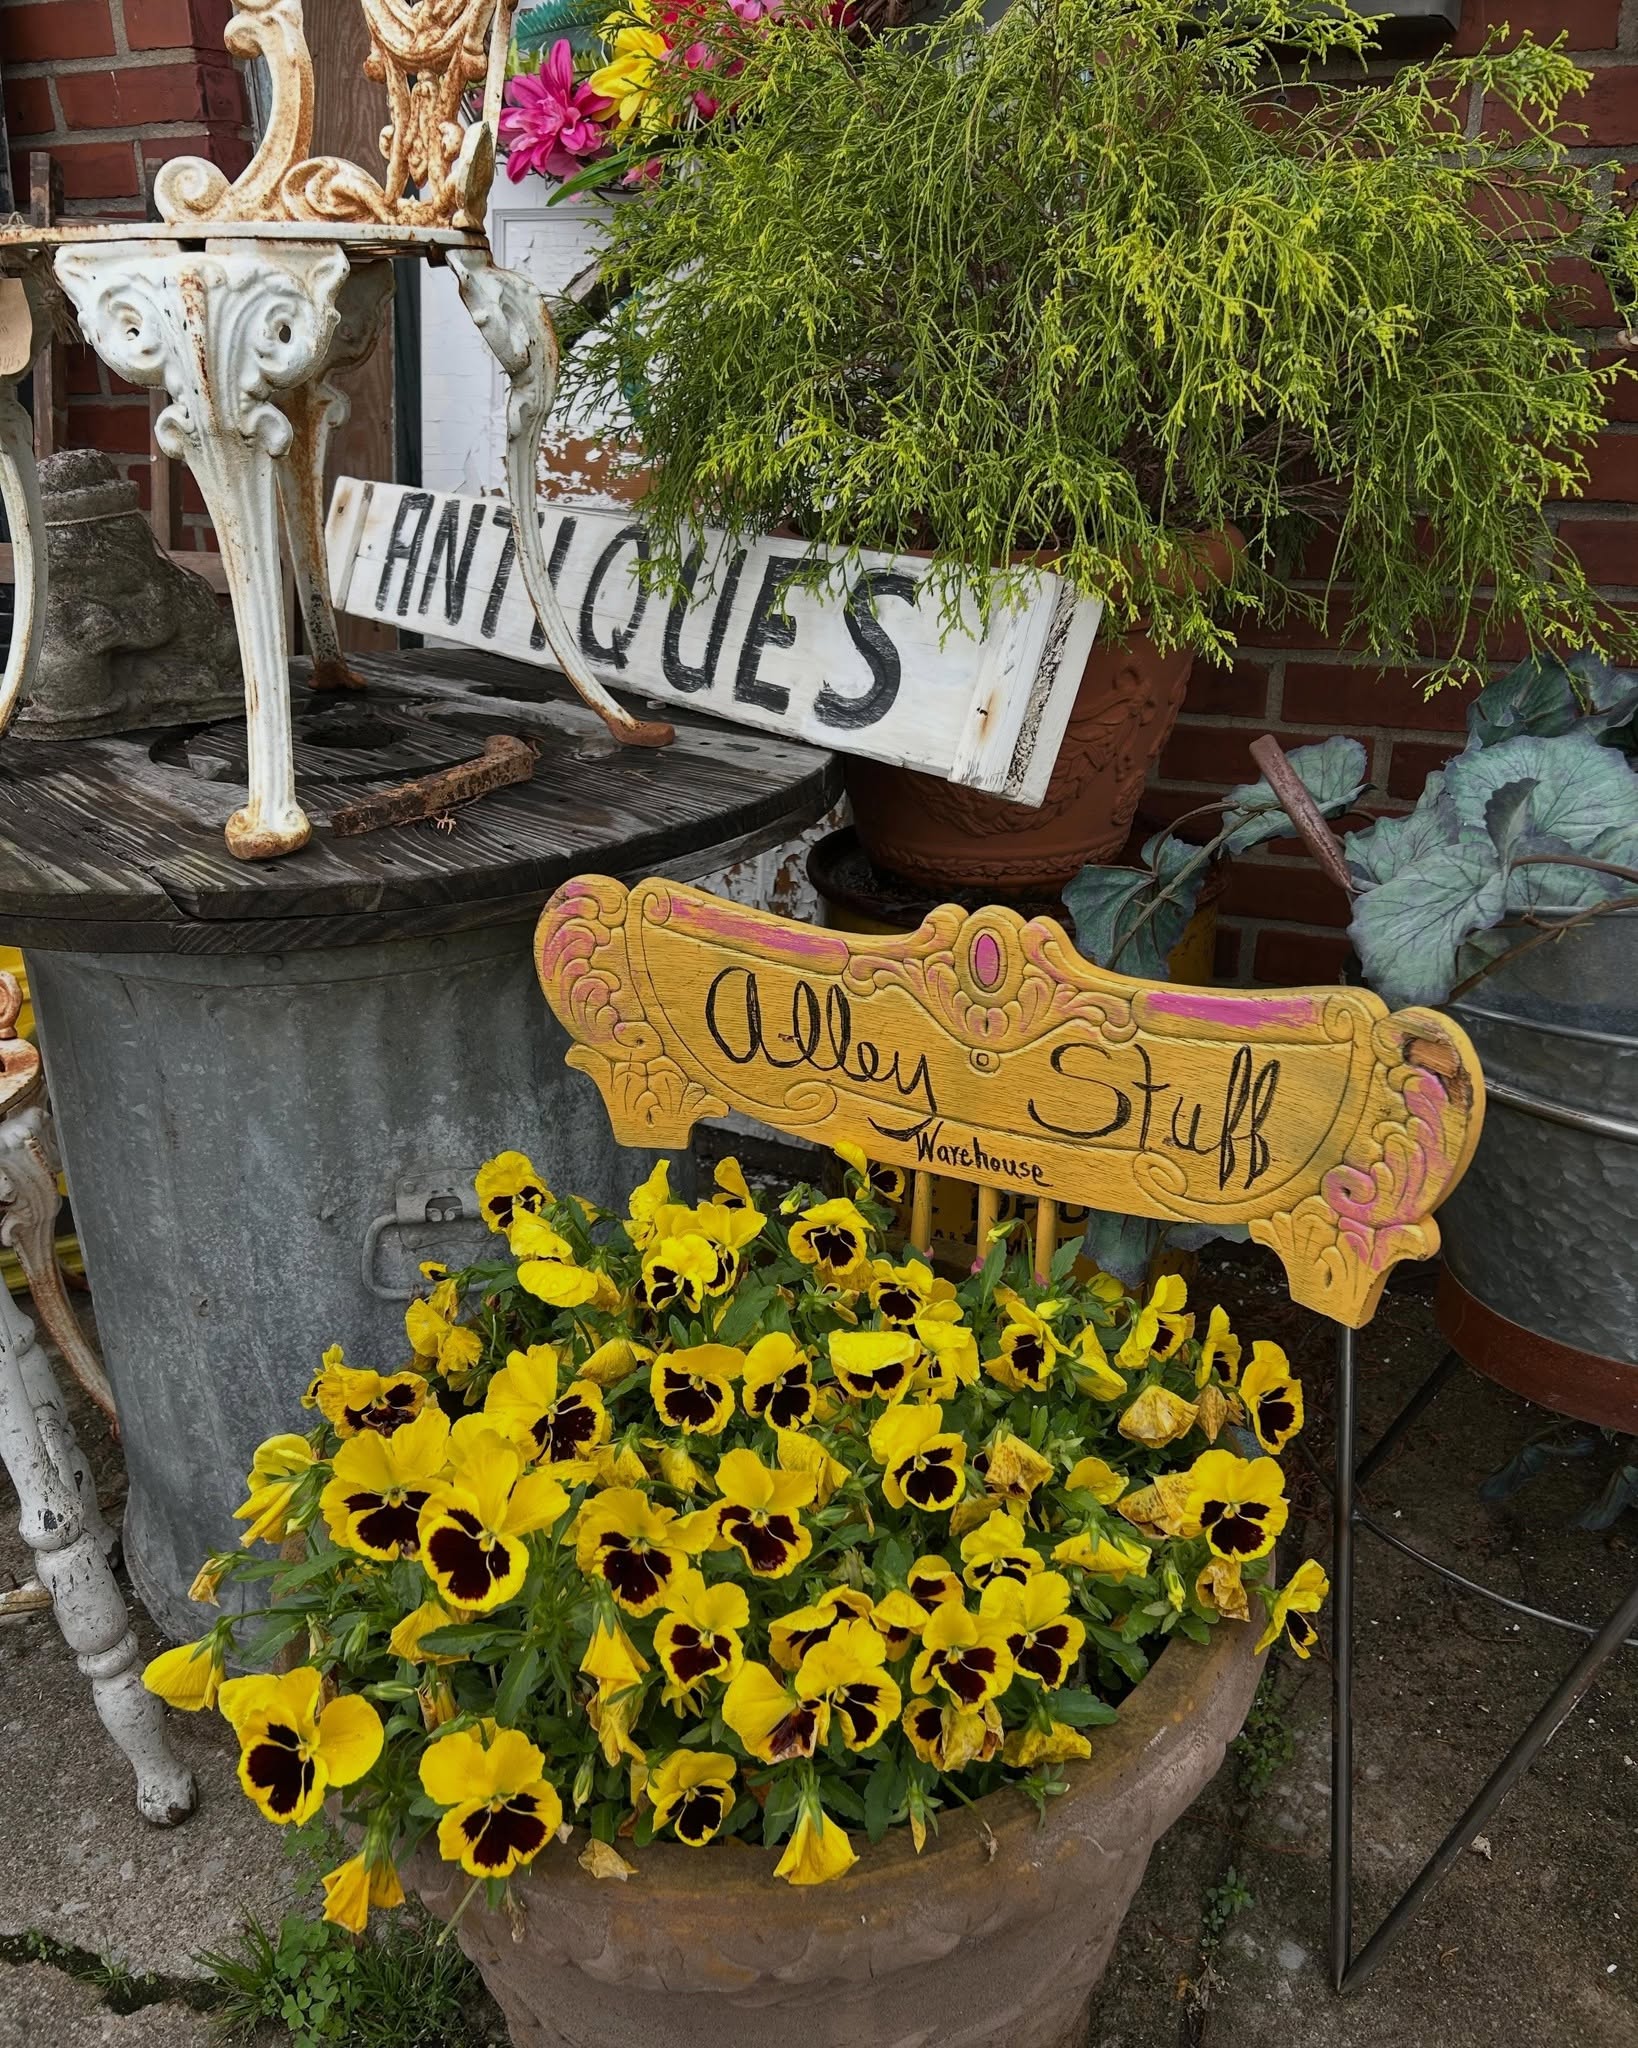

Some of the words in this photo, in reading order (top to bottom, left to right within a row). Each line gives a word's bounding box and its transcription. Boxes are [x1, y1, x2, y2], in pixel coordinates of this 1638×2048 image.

[375, 492, 918, 728] ANTIQUES
[916, 1121, 1053, 1187] Warehouse
[1028, 1042, 1281, 1191] Stuff
